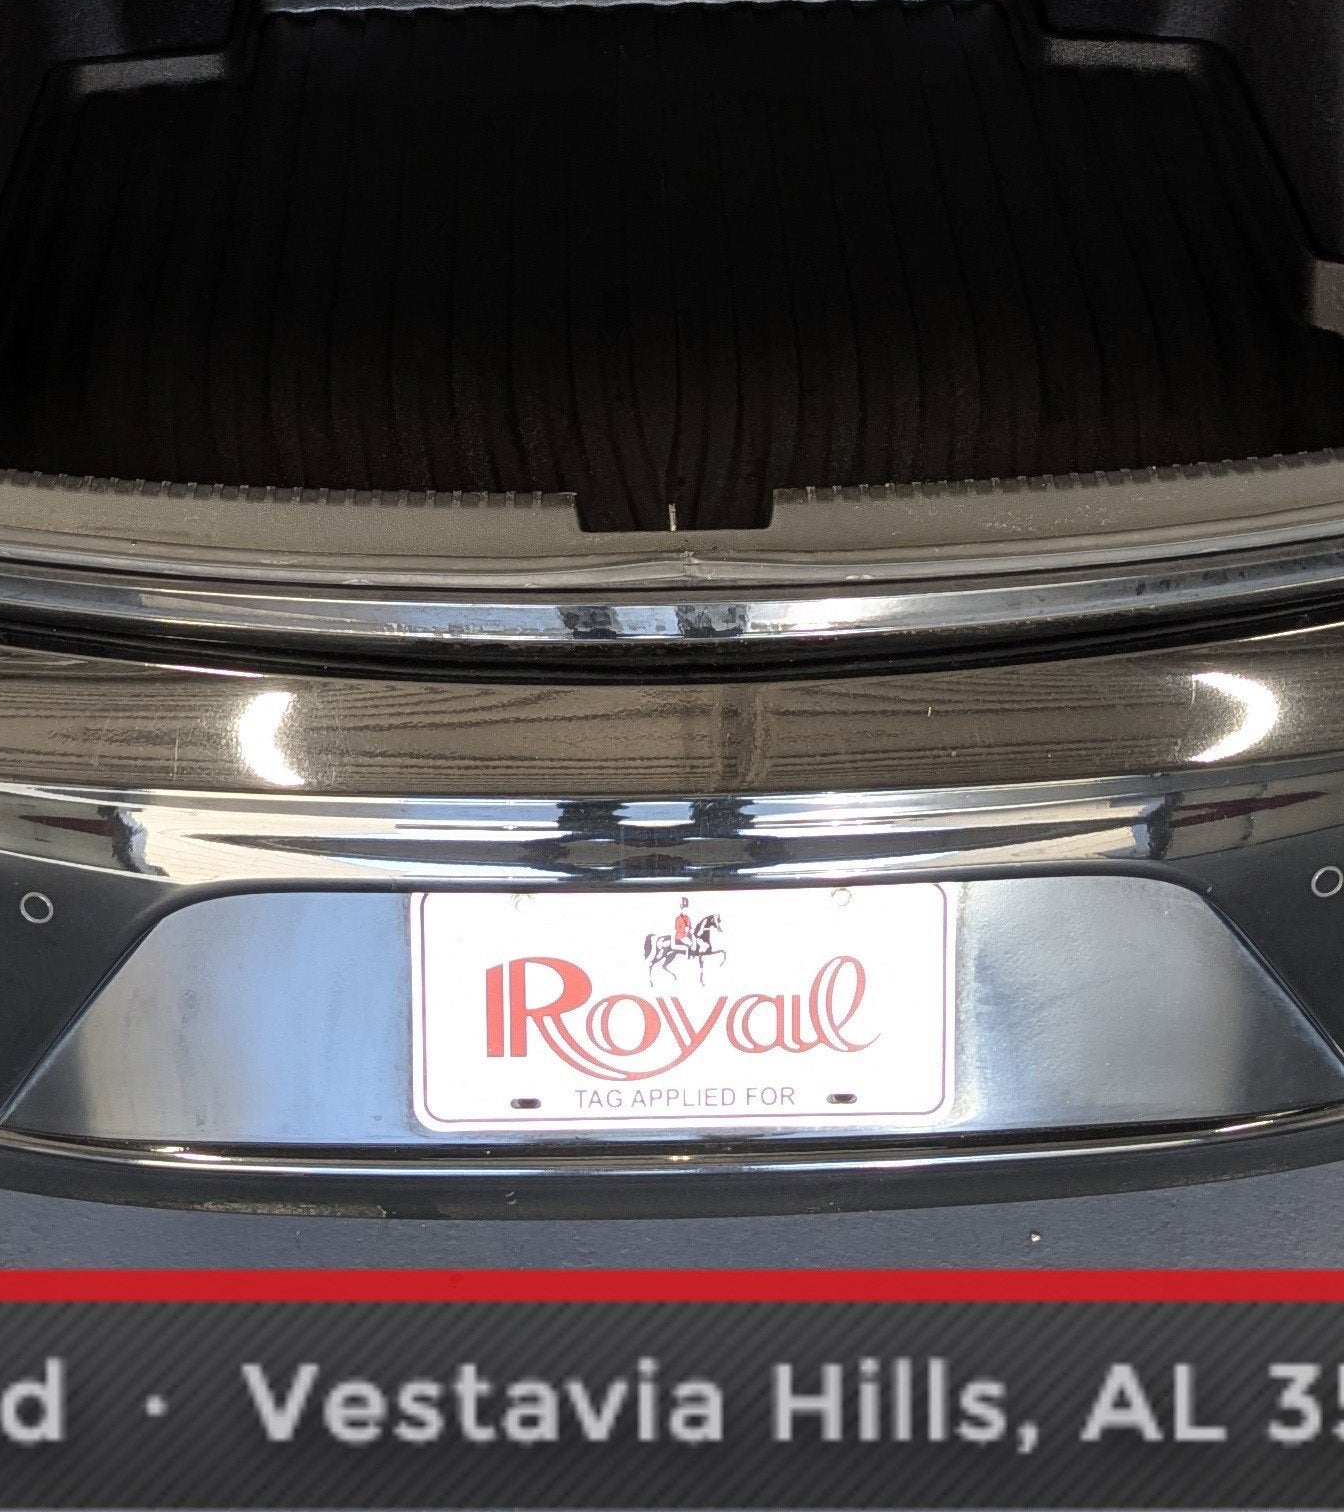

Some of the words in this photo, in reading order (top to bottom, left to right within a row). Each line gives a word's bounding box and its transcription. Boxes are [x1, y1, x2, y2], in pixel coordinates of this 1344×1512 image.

[485, 955, 882, 1081] Royal
[574, 1089, 624, 1109] TAG
[630, 1088, 737, 1108] APPLIED
[745, 1086, 796, 1106] FOR
